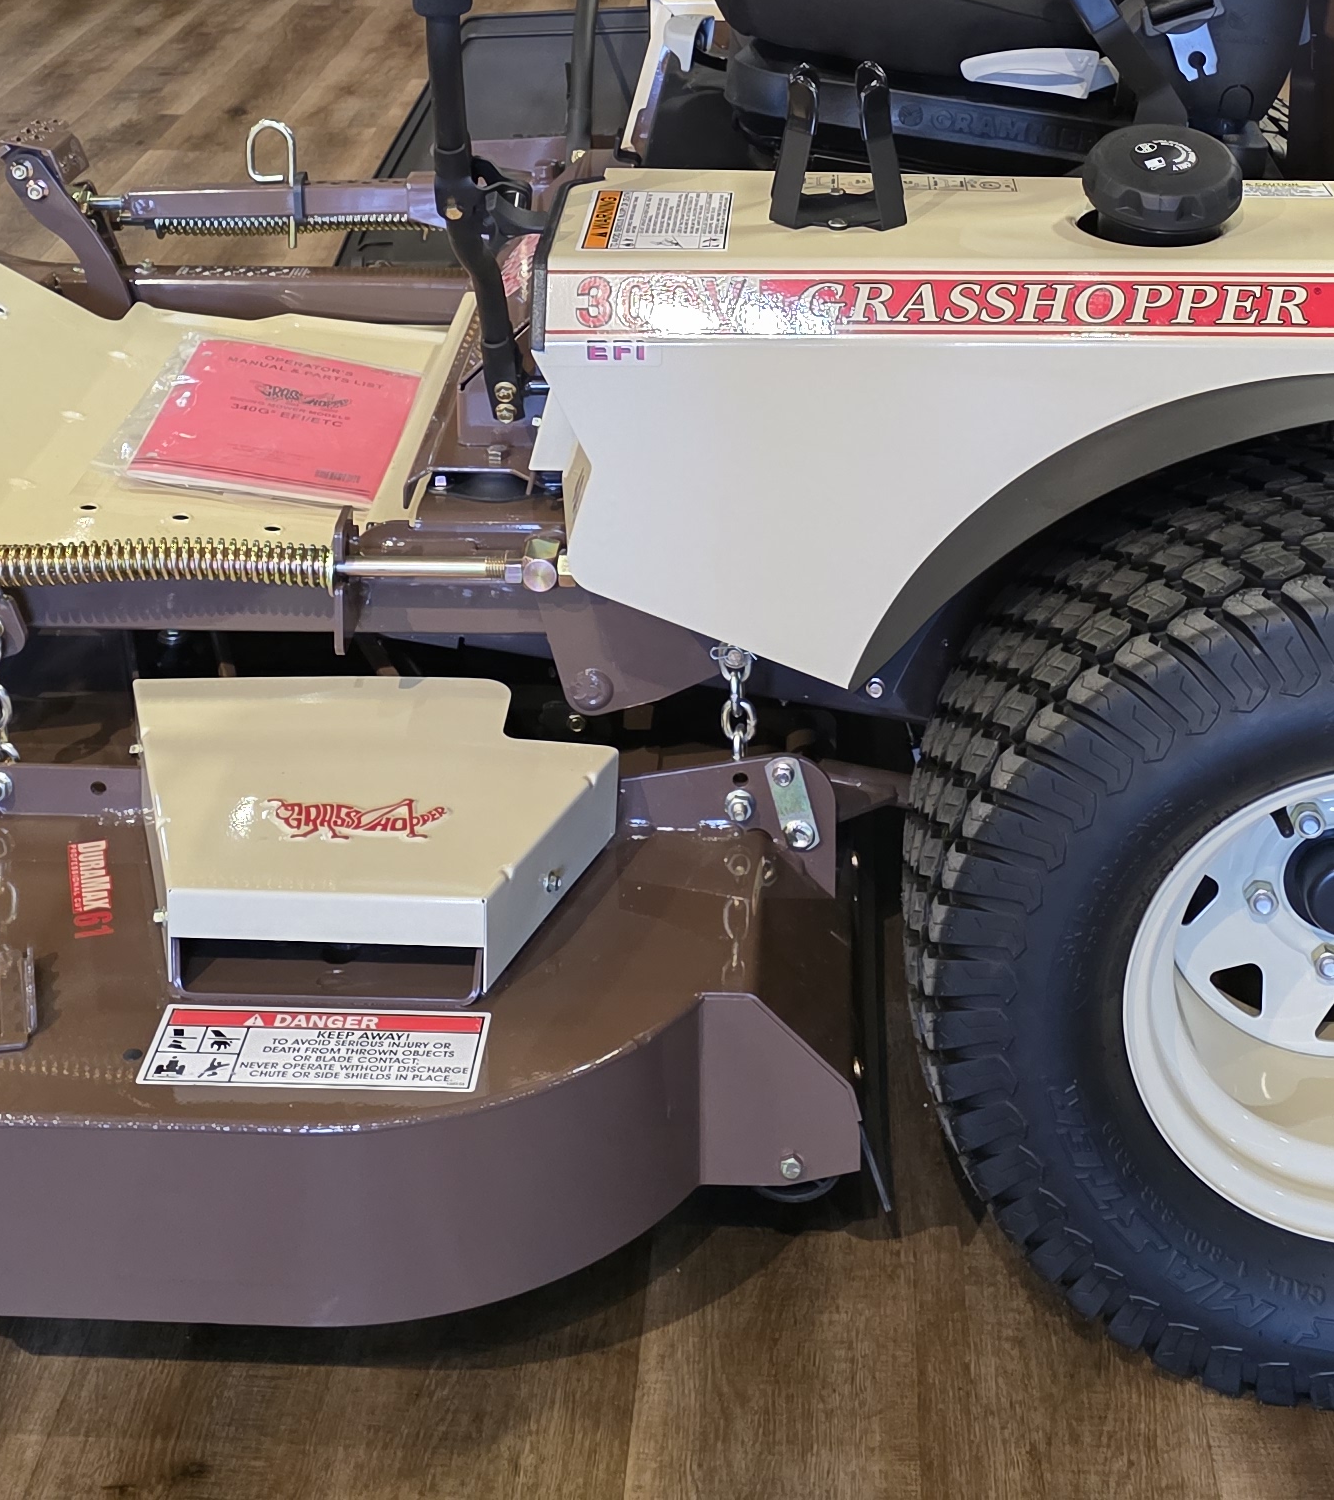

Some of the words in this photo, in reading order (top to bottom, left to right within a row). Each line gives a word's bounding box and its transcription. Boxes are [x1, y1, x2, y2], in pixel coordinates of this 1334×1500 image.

[592, 197, 617, 230] WARNING
[798, 280, 1308, 327] GRASSHOPPER
[586, 339, 646, 361] EFI
[228, 356, 288, 373] MANUAL
[304, 371, 350, 384] PARTS
[354, 379, 384, 390] LIST
[264, 355, 354, 377] OPERATOR'S
[280, 411, 344, 428] EFI/ETC
[74, 897, 83, 912] CUT
[73, 911, 114, 939] 61
[274, 1014, 379, 1029] DANGER
[272, 1038, 288, 1046] TO
[295, 1038, 330, 1047] AVOID
[334, 1039, 384, 1049] SERIOUS
[388, 1041, 429, 1050] INJURY
[433, 1042, 451, 1050] OR
[316, 1030, 355, 1040] KEEP
[358, 1031, 410, 1042] AWAY!
[262, 1045, 301, 1055] DEATH
[304, 1046, 341, 1056] FROM
[344, 1047, 395, 1057] THROWN
[400, 1049, 455, 1059] OBJECTS
[293, 1054, 311, 1063] OR
[316, 1055, 352, 1064] BLADE
[240, 1061, 279, 1071] NEVER
[283, 1062, 336, 1073] OPERATE
[339, 1064, 393, 1074] WITHOUT
[396, 1065, 469, 1076] DISCHARGE
[249, 1069, 296, 1079] CHUTE
[300, 1071, 312, 1080] OR
[314, 1071, 340, 1081] SIDE
[344, 1072, 391, 1082] SHIELDS
[394, 1074, 407, 1083] IN
[411, 1074, 453, 1084] PLACE.
[1041, 1077, 1280, 1335] MASTER
[1259, 1266, 1328, 1305] CALL
